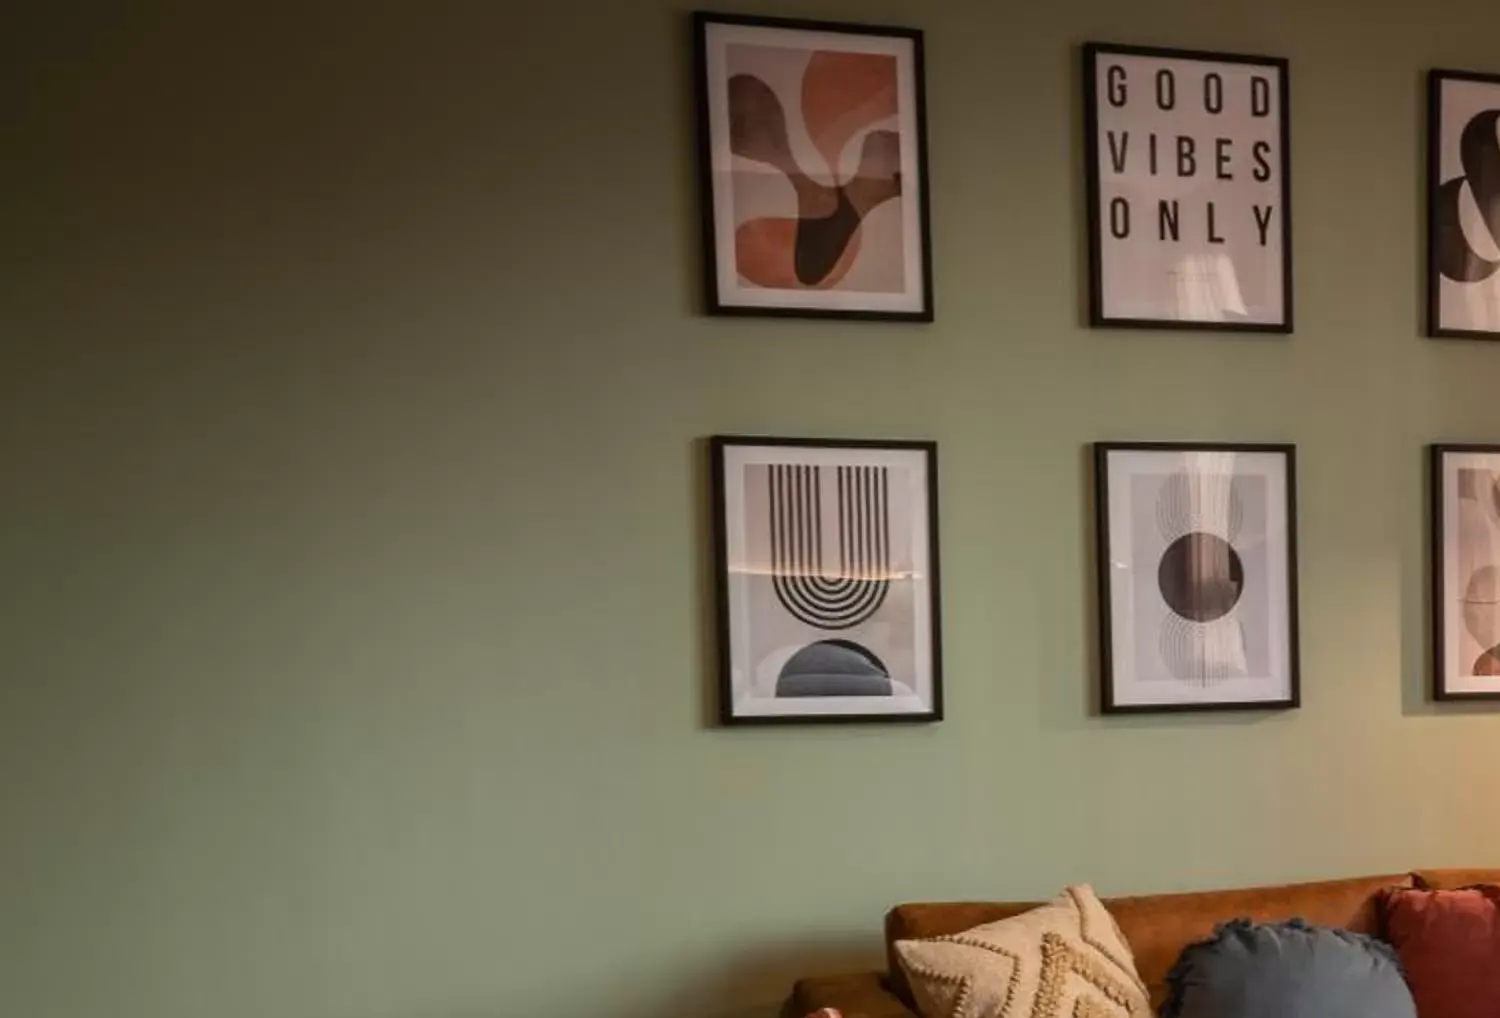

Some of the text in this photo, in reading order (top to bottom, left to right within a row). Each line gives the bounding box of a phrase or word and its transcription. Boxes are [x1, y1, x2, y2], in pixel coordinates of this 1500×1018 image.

[1107, 65, 1270, 118] GOOD
[1107, 130, 1271, 183] VIBES
[1110, 196, 1273, 247] ONLY
